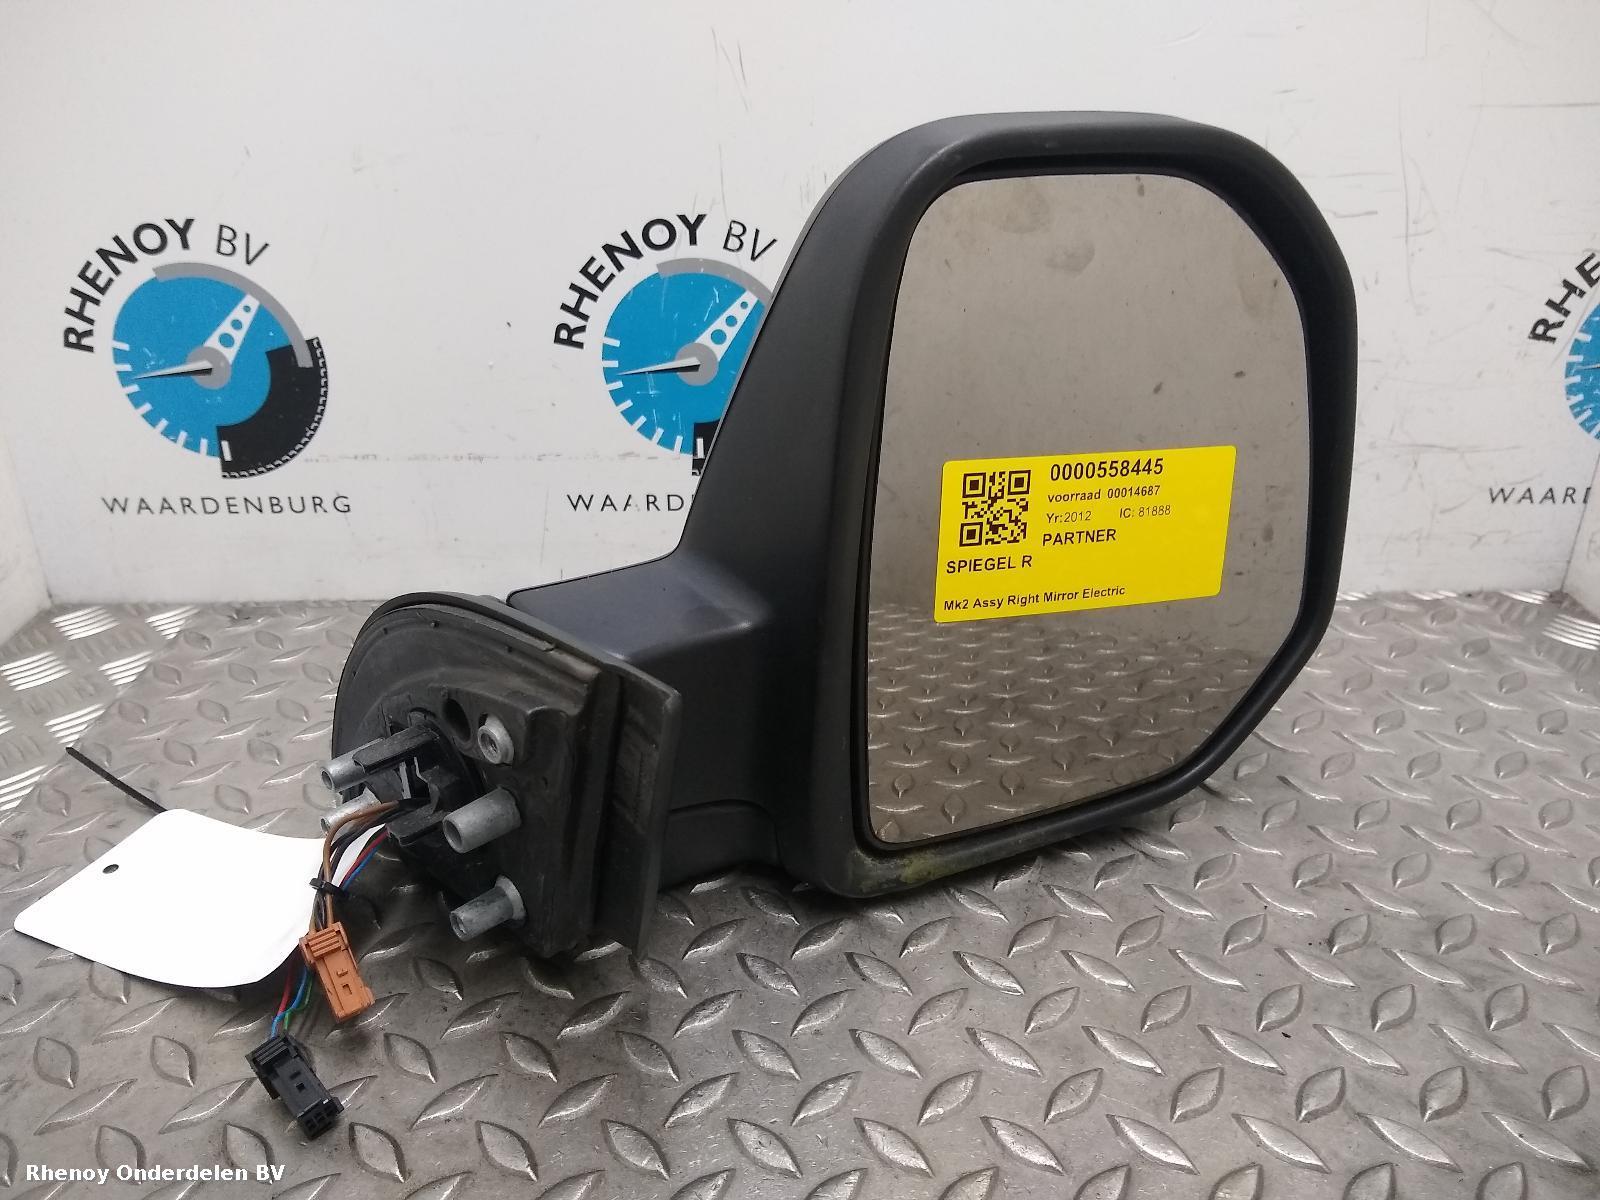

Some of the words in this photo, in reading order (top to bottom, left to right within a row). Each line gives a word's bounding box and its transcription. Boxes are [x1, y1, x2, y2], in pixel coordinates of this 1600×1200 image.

[63, 217, 195, 352] RHENOY
[216, 224, 270, 266] BV
[554, 213, 707, 350] RHENOY
[722, 219, 778, 263] BV
[1527, 252, 1600, 344] RHE
[1050, 457, 1164, 481] 0000558445
[1047, 489, 1102, 503] voorraad
[1107, 485, 1161, 499] 00014687
[101, 495, 351, 516] WAARDENBURG
[1046, 510, 1092, 524] Yr:2012
[1119, 508, 1135, 519] IC:
[1138, 504, 1172, 517] 81888
[1042, 528, 1118, 547] PARTNER
[946, 556, 1017, 574] SPIEGEL
[1021, 555, 1033, 568] R
[943, 600, 970, 611] Mk2
[972, 597, 1004, 610] Assy
[1007, 593, 1041, 607] Right
[1043, 590, 1080, 603] Mirror
[1082, 586, 1126, 599] Electric
